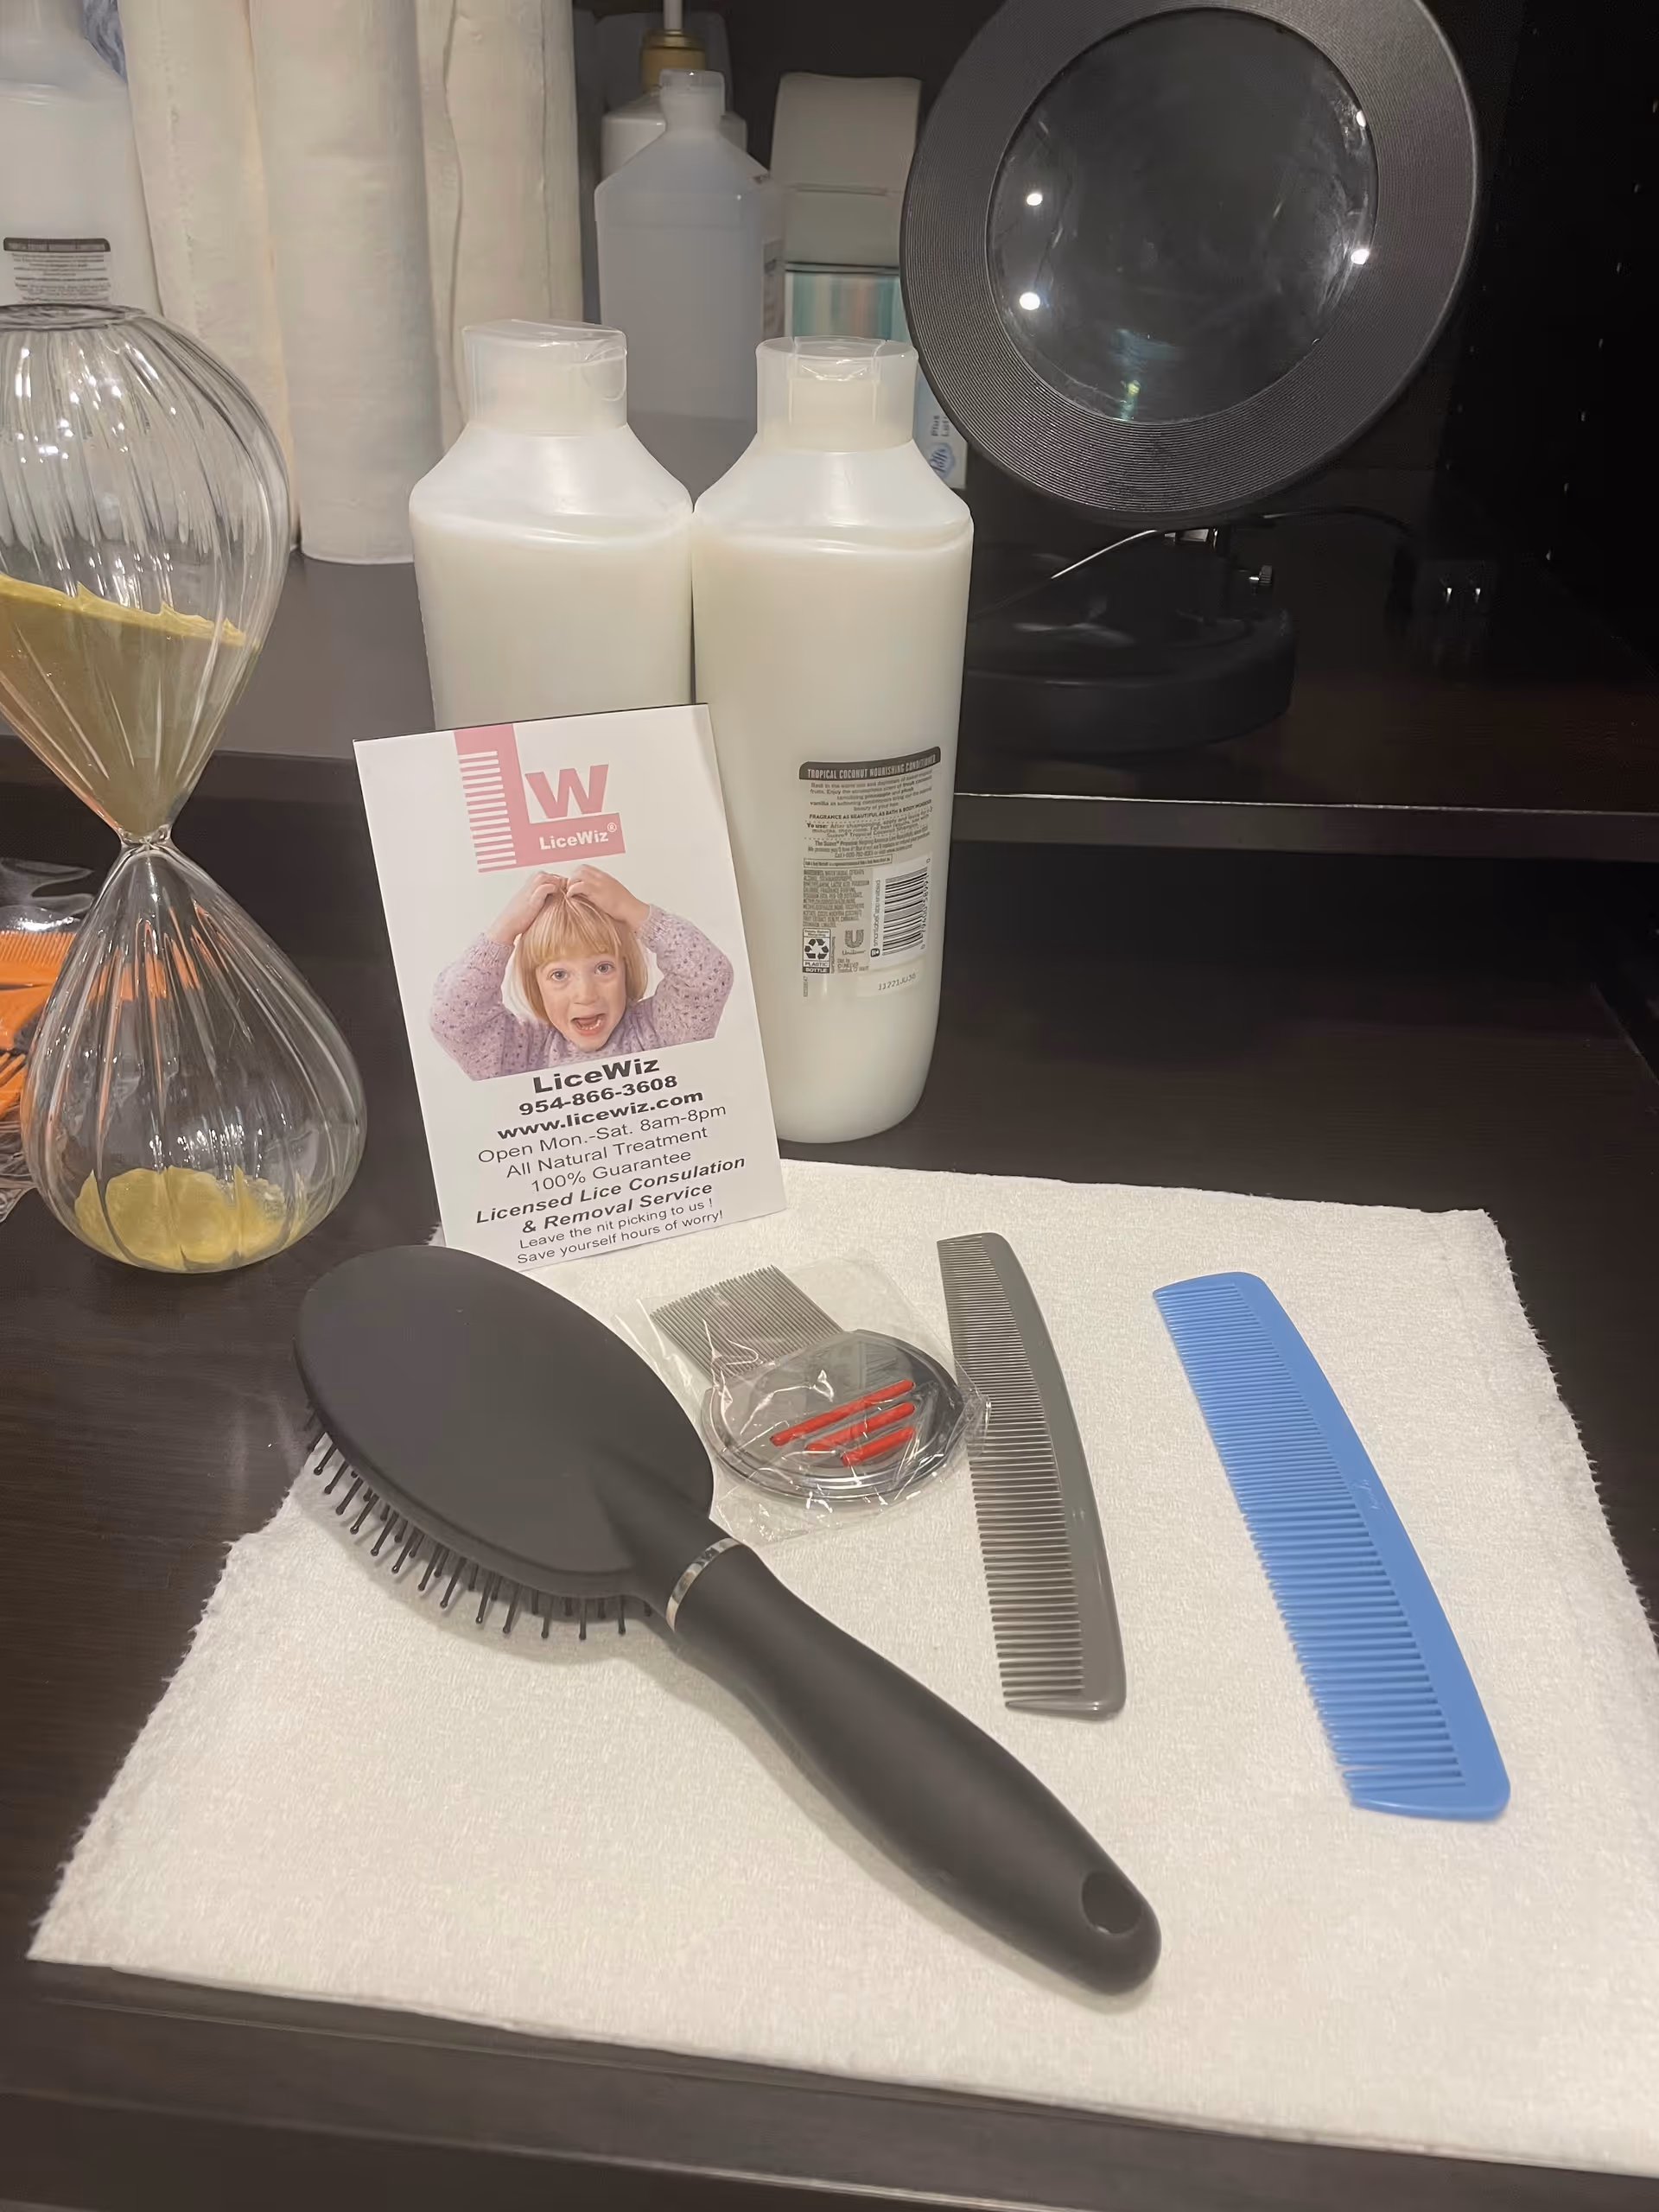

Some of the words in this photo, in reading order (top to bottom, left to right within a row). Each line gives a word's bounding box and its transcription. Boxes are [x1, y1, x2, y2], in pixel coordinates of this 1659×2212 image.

[808, 769, 836, 779] TROPICAL
[839, 769, 868, 779] COCONUT
[869, 764, 905, 777] NOURISHING
[518, 1075, 678, 1116] 954-866-3608
[532, 1058, 660, 1095] LiceWiz
[478, 1144, 533, 1164] Open
[539, 1123, 633, 1153] Mon.-Sat.
[639, 1105, 727, 1132] 8am-8pm
[496, 1091, 704, 1141] www.licewiz.com
[505, 1161, 531, 1179] All
[537, 1146, 608, 1173] Natural
[612, 1126, 709, 1156] Treatment
[531, 1170, 587, 1192] 100%
[592, 1151, 691, 1179] Guarantee
[475, 1192, 574, 1224] Licensed
[580, 1185, 622, 1203] Lice
[628, 1158, 746, 1192] Consulation
[522, 1219, 537, 1234] &
[543, 1198, 633, 1230] Removal
[639, 1184, 713, 1209] Service
[517, 1249, 556, 1264] Save
[559, 1233, 617, 1258] yourself
[620, 1225, 661, 1242] hours
[664, 1219, 677, 1231] of
[681, 1209, 723, 1228] worry!
[519, 1233, 565, 1249] Leave
[569, 1227, 593, 1238] the
[596, 1220, 614, 1233] nit
[618, 1210, 667, 1230] picking
[670, 1206, 684, 1216] to
